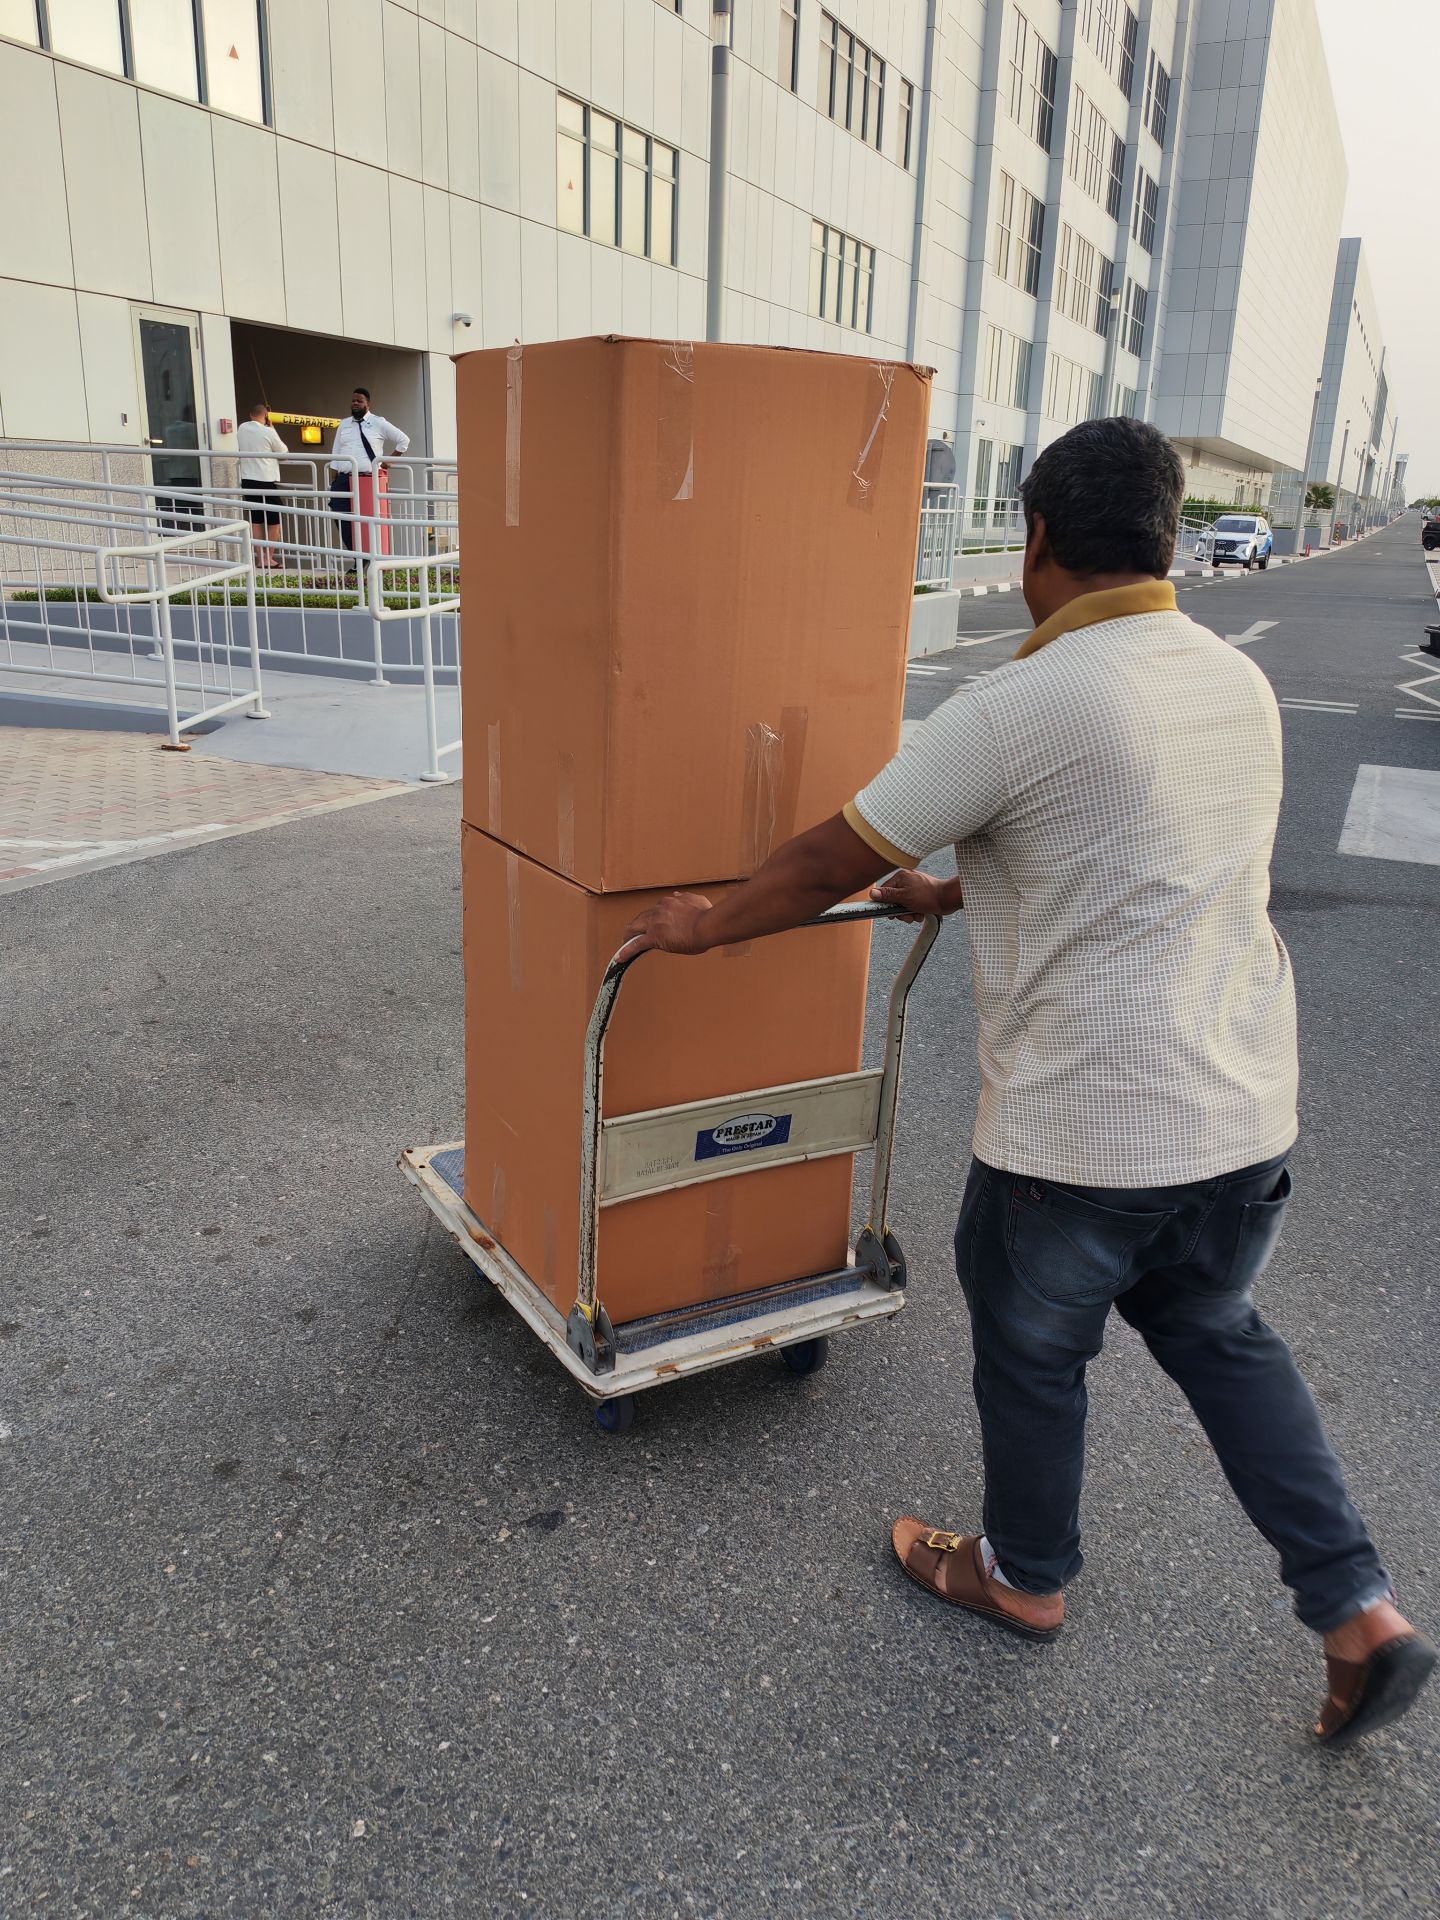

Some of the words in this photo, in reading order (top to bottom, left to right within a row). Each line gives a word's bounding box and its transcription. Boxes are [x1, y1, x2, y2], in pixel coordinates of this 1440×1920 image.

[282, 415, 334, 428] CLEARANCE
[715, 1119, 773, 1139] PRESTAR
[743, 1140, 763, 1151] Original
